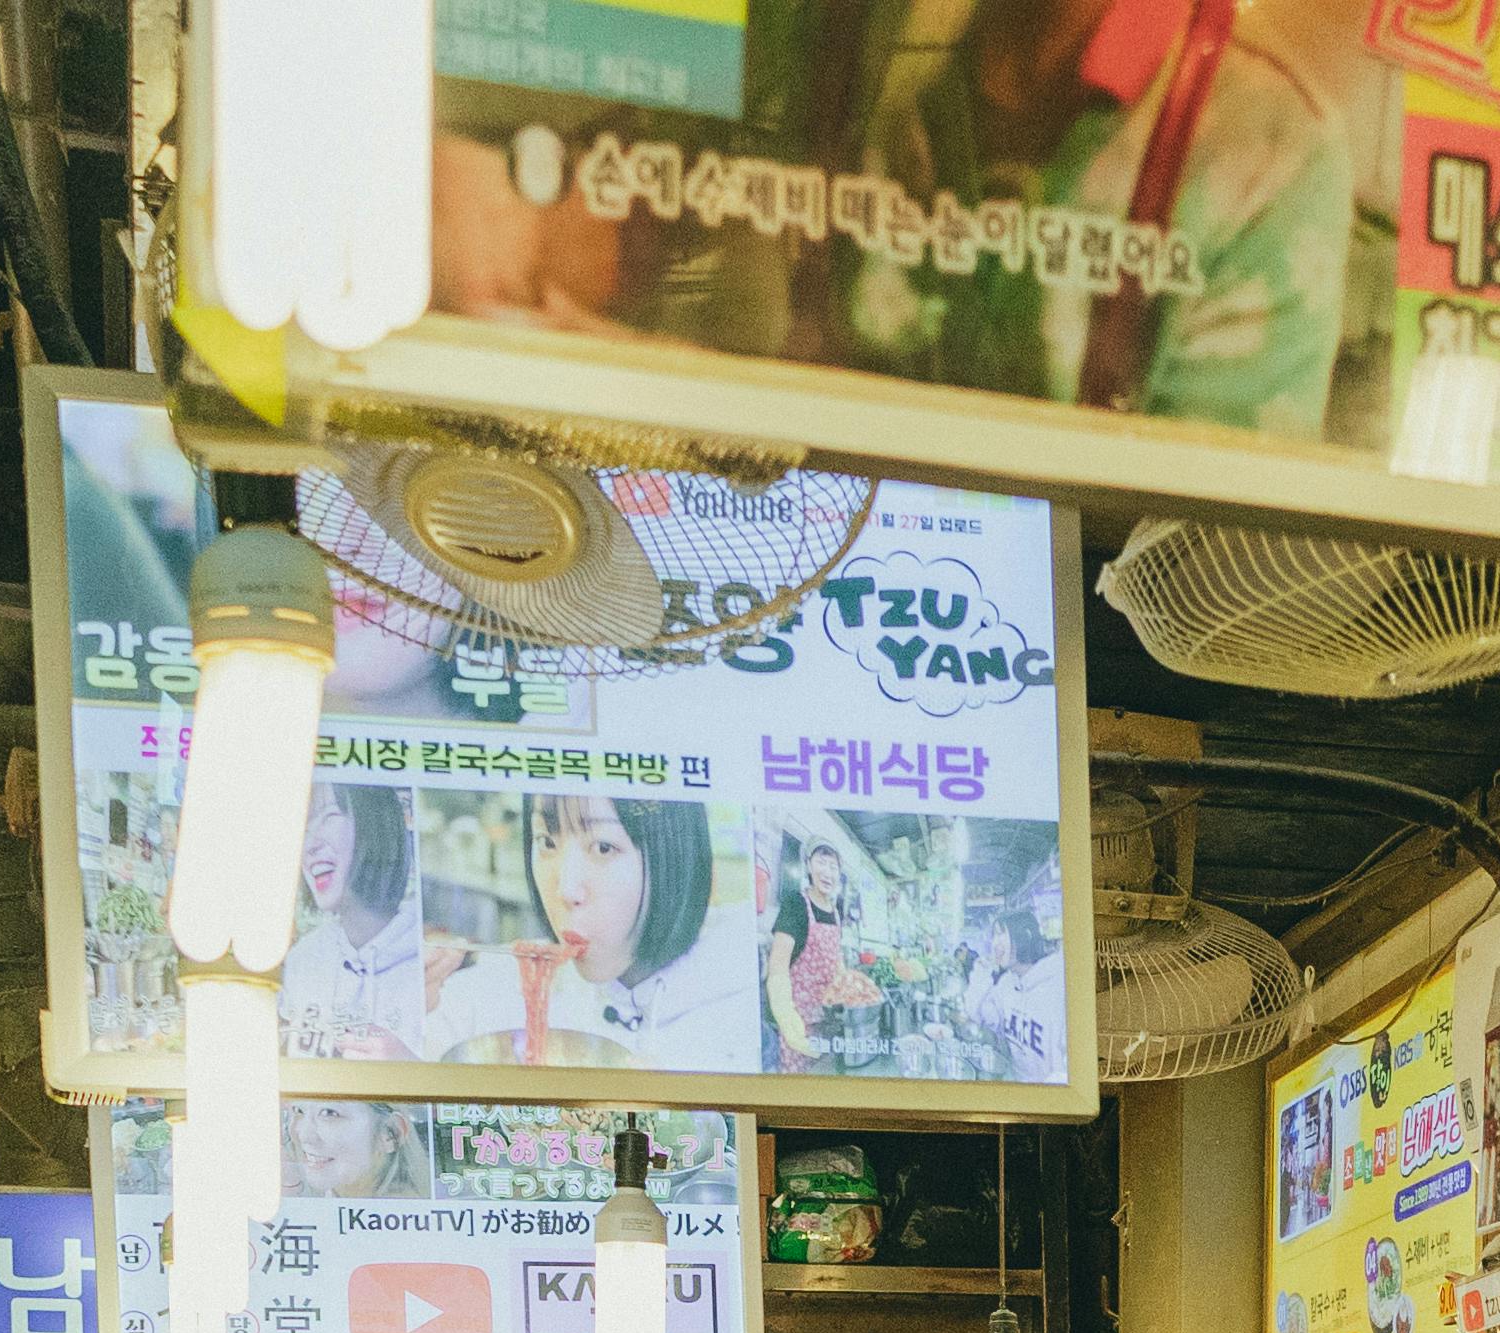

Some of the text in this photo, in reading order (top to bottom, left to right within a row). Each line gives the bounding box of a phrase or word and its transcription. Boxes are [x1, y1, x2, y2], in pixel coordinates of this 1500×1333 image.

[579, 133, 679, 220] 손에
[687, 152, 826, 241] 수제비
[680, 480, 795, 523] YouTube
[900, 514, 935, 532] 27일
[938, 515, 984, 536] 업로드
[820, 575, 969, 630] TZU
[876, 634, 1056, 688] YANG
[313, 735, 712, 789] 문시장 칼국수골목 먹방 편
[759, 734, 990, 803] 남해식당
[1350, 1063, 1368, 1101] SBS
[262, 1216, 322, 1277] 海
[338, 1208, 476, 1237] [KaoruTV]
[120, 1241, 144, 1265] 남
[1365, 1251, 1378, 1276] 04
